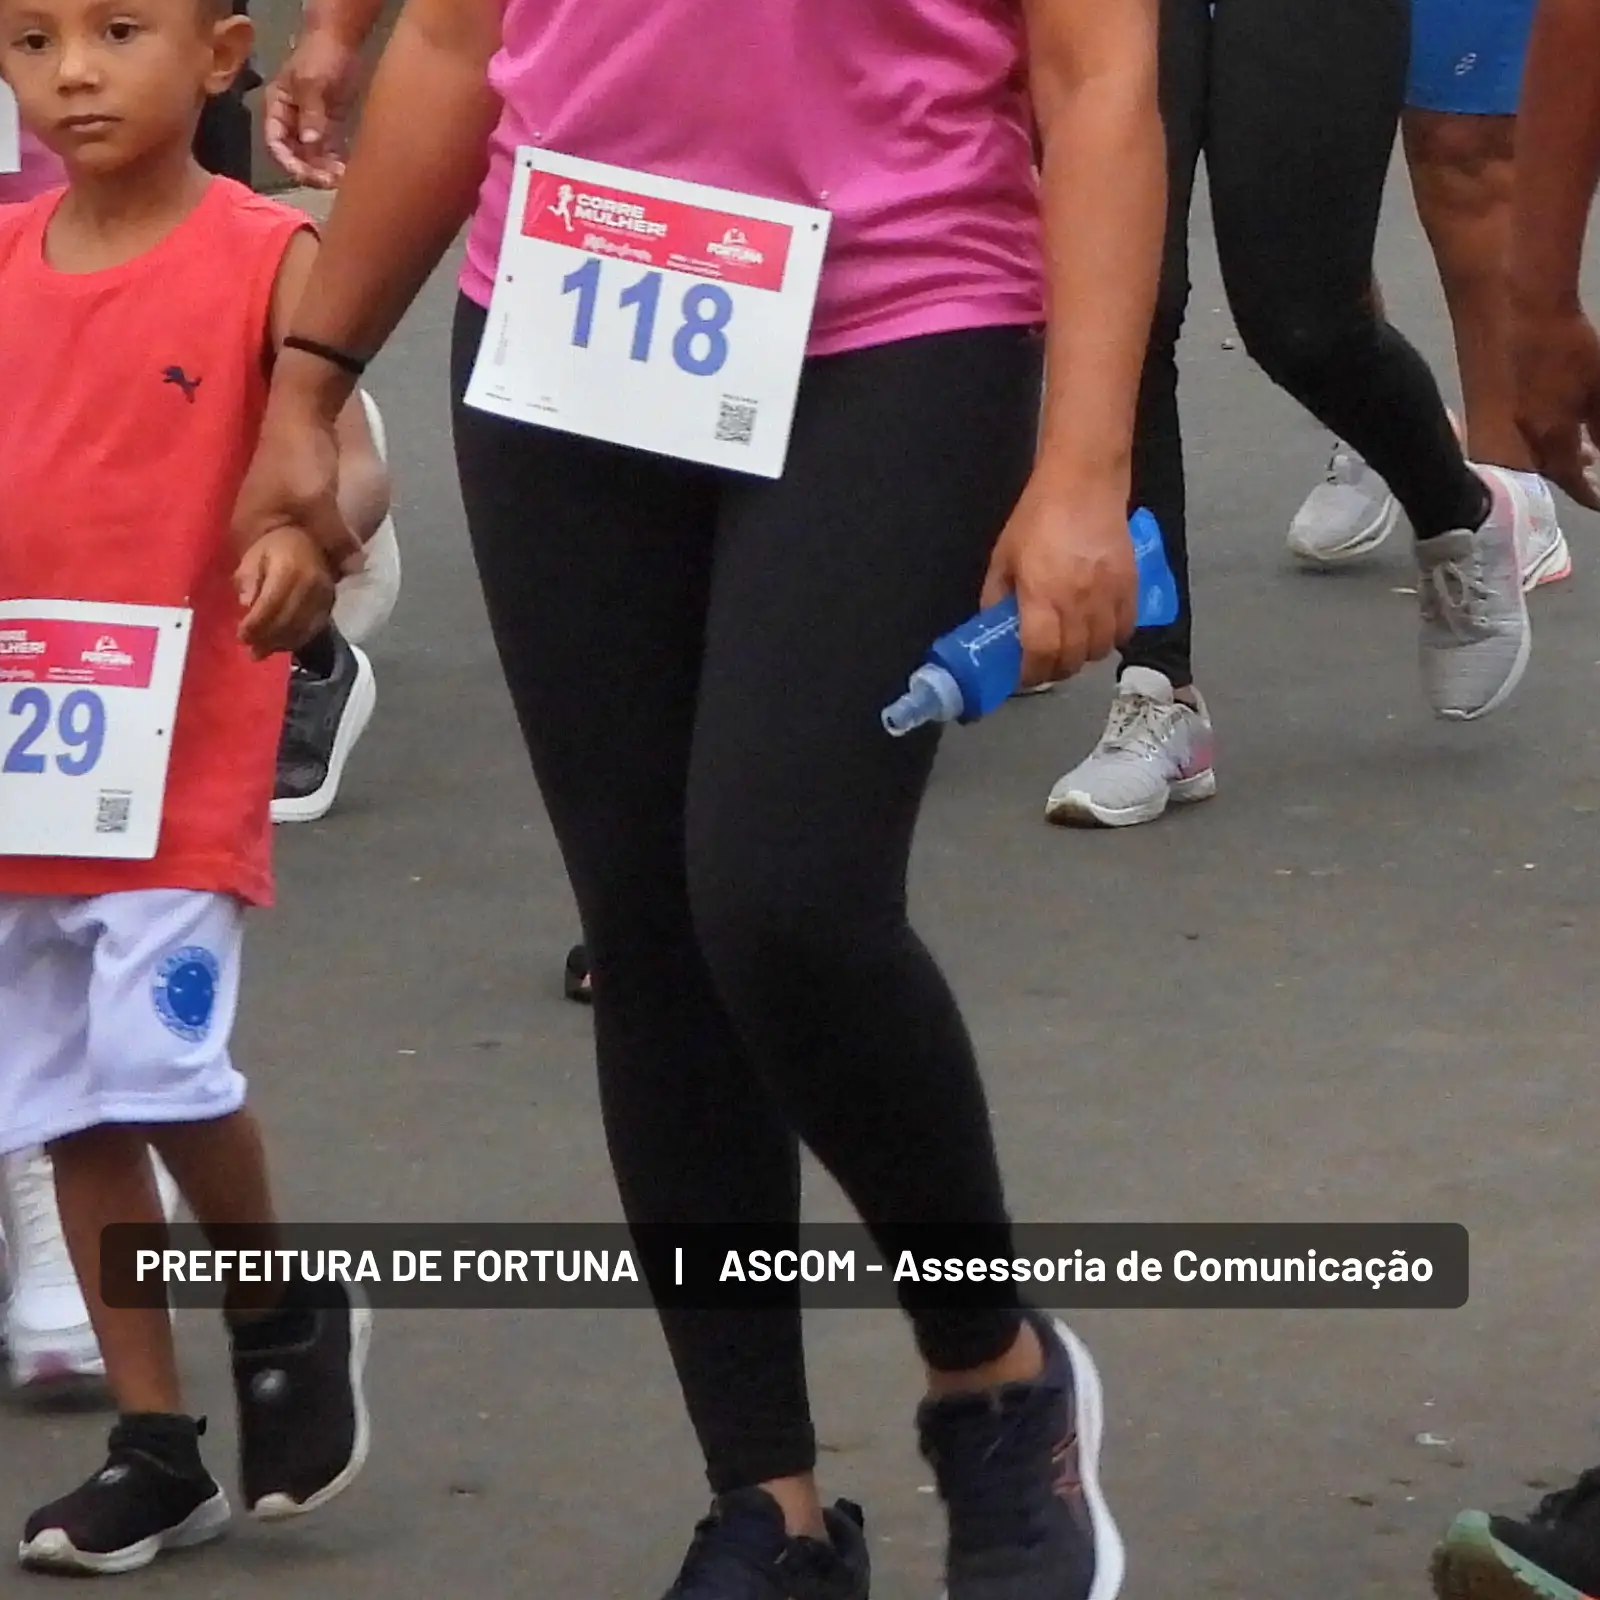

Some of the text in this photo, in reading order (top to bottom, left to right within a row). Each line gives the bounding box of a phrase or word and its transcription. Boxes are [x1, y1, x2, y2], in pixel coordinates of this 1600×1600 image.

[574, 205, 668, 238] MULHER!
[577, 193, 646, 220] CORRE
[561, 257, 733, 376] 118
